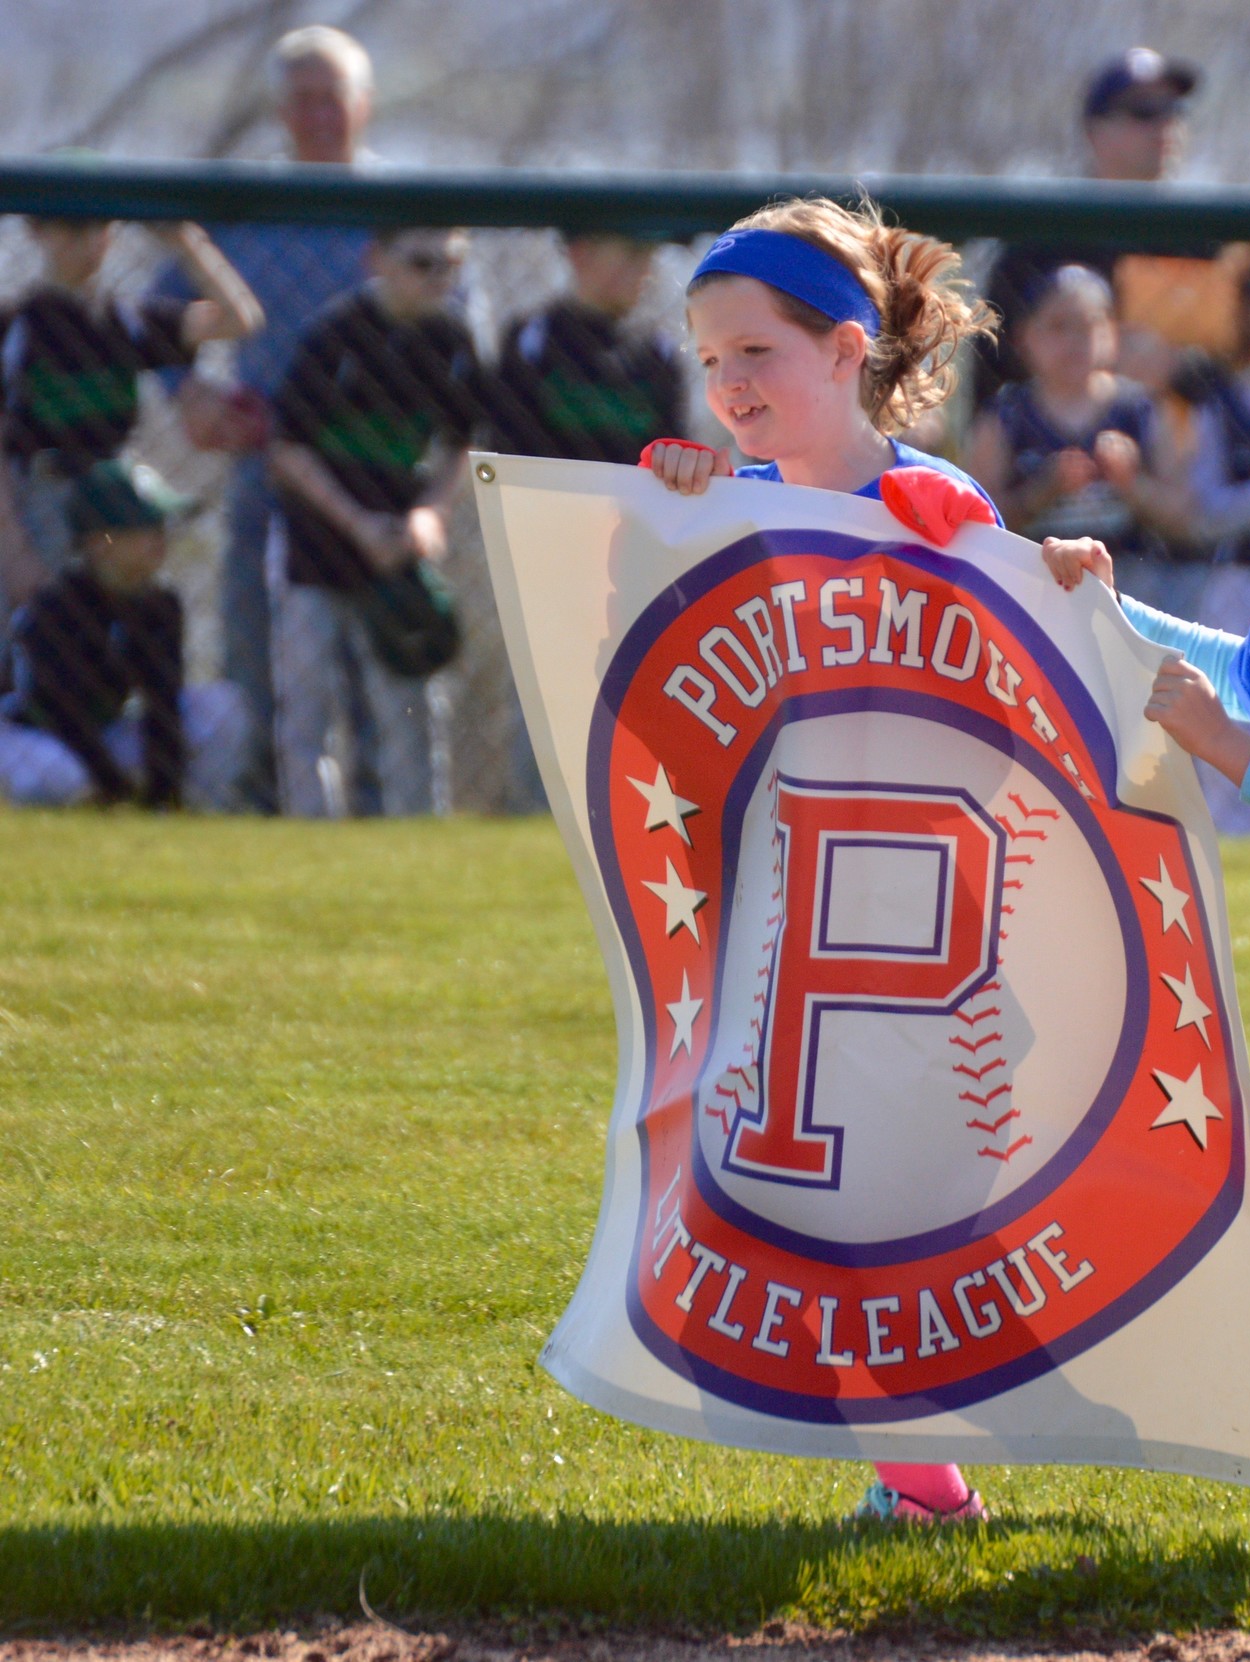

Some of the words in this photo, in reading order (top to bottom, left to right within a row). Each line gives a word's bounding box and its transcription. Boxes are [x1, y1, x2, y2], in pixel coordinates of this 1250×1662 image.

[721, 769, 1007, 1191] P
[652, 1163, 803, 1359] LITTLE
[815, 1221, 1095, 1368] LEAGUE
